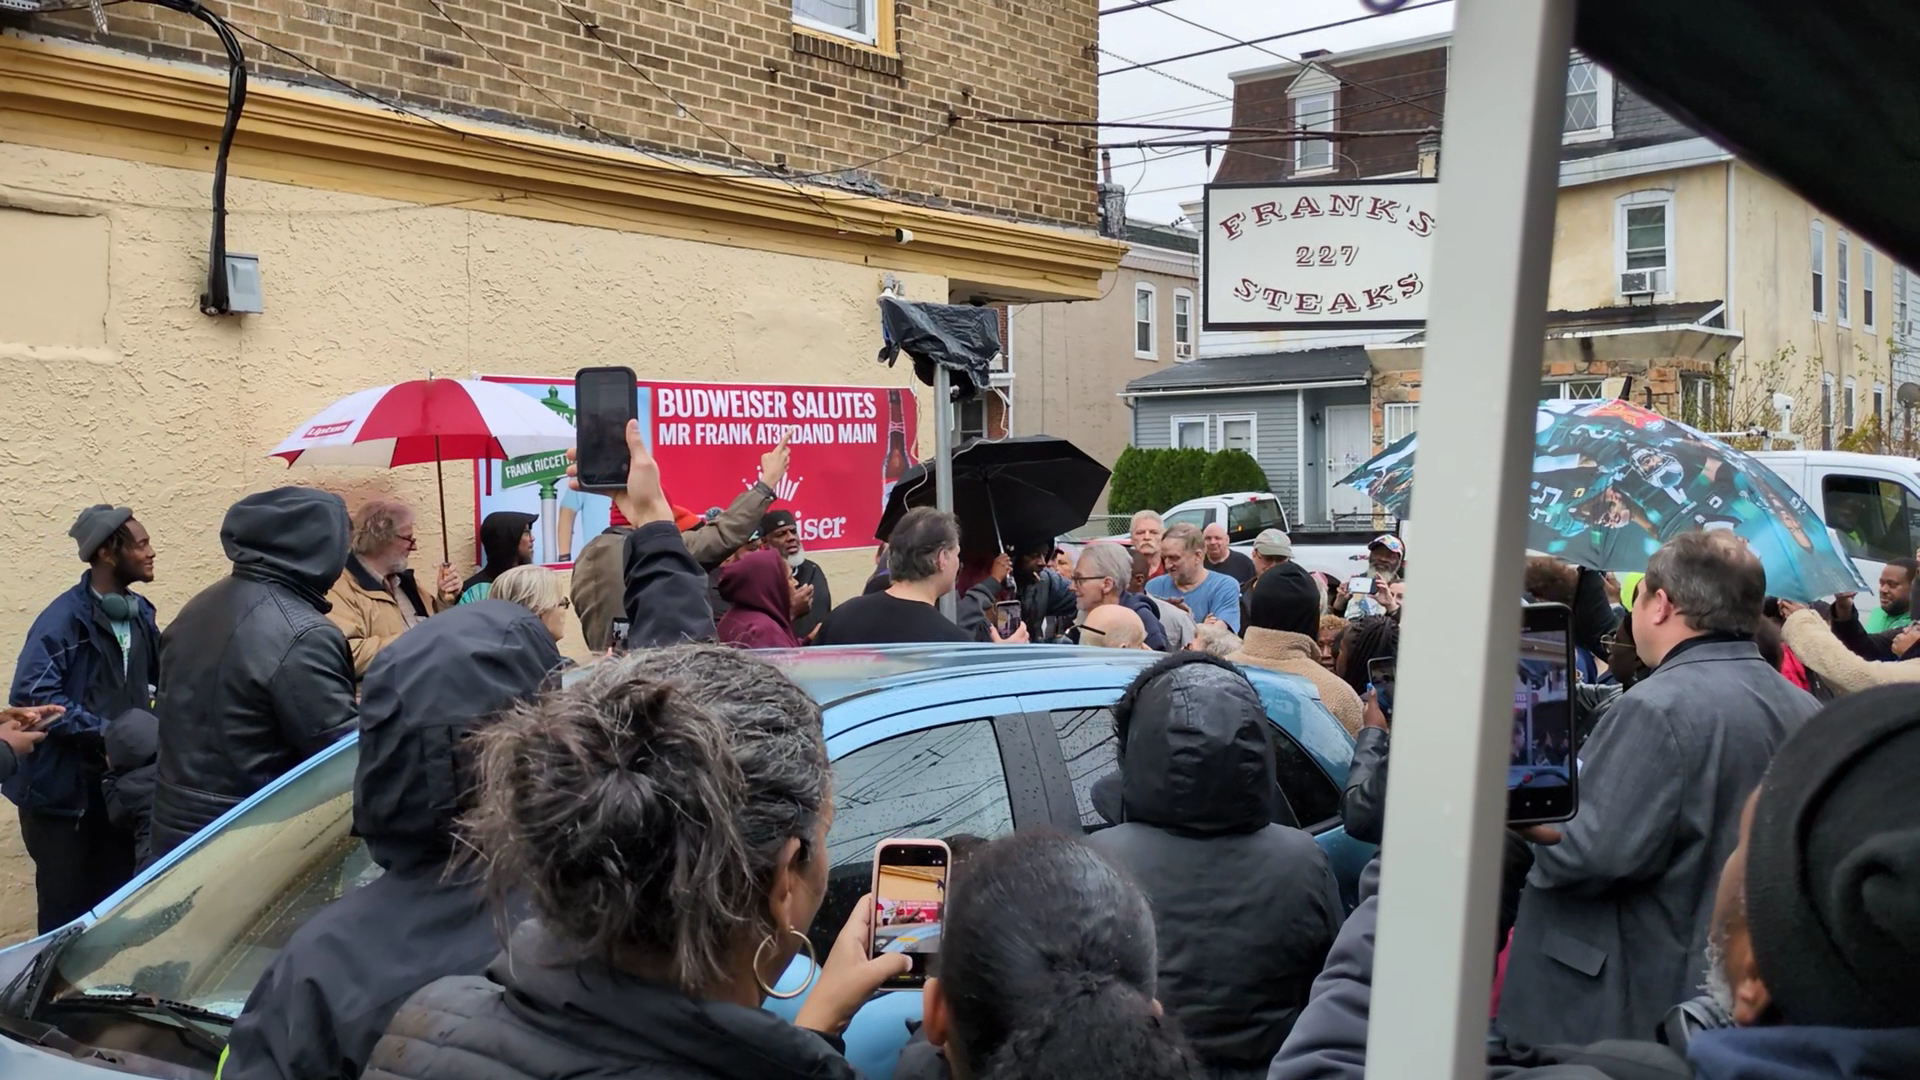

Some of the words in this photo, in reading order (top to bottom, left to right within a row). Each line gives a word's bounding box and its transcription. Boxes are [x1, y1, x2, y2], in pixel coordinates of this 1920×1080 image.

[1219, 194, 1437, 240] FRANK'S
[1295, 246, 1359, 267] 227
[1233, 273, 1424, 314] STEAKS
[657, 388, 788, 419] BUDWEISER
[792, 391, 877, 419] SALUTES
[306, 424, 349, 437] Lipton
[659, 423, 692, 445] MR
[695, 423, 753, 445] FRANK
[838, 423, 878, 444] MAIN
[505, 461, 534, 479] FRANK
[534, 452, 575, 472] RICCETT
